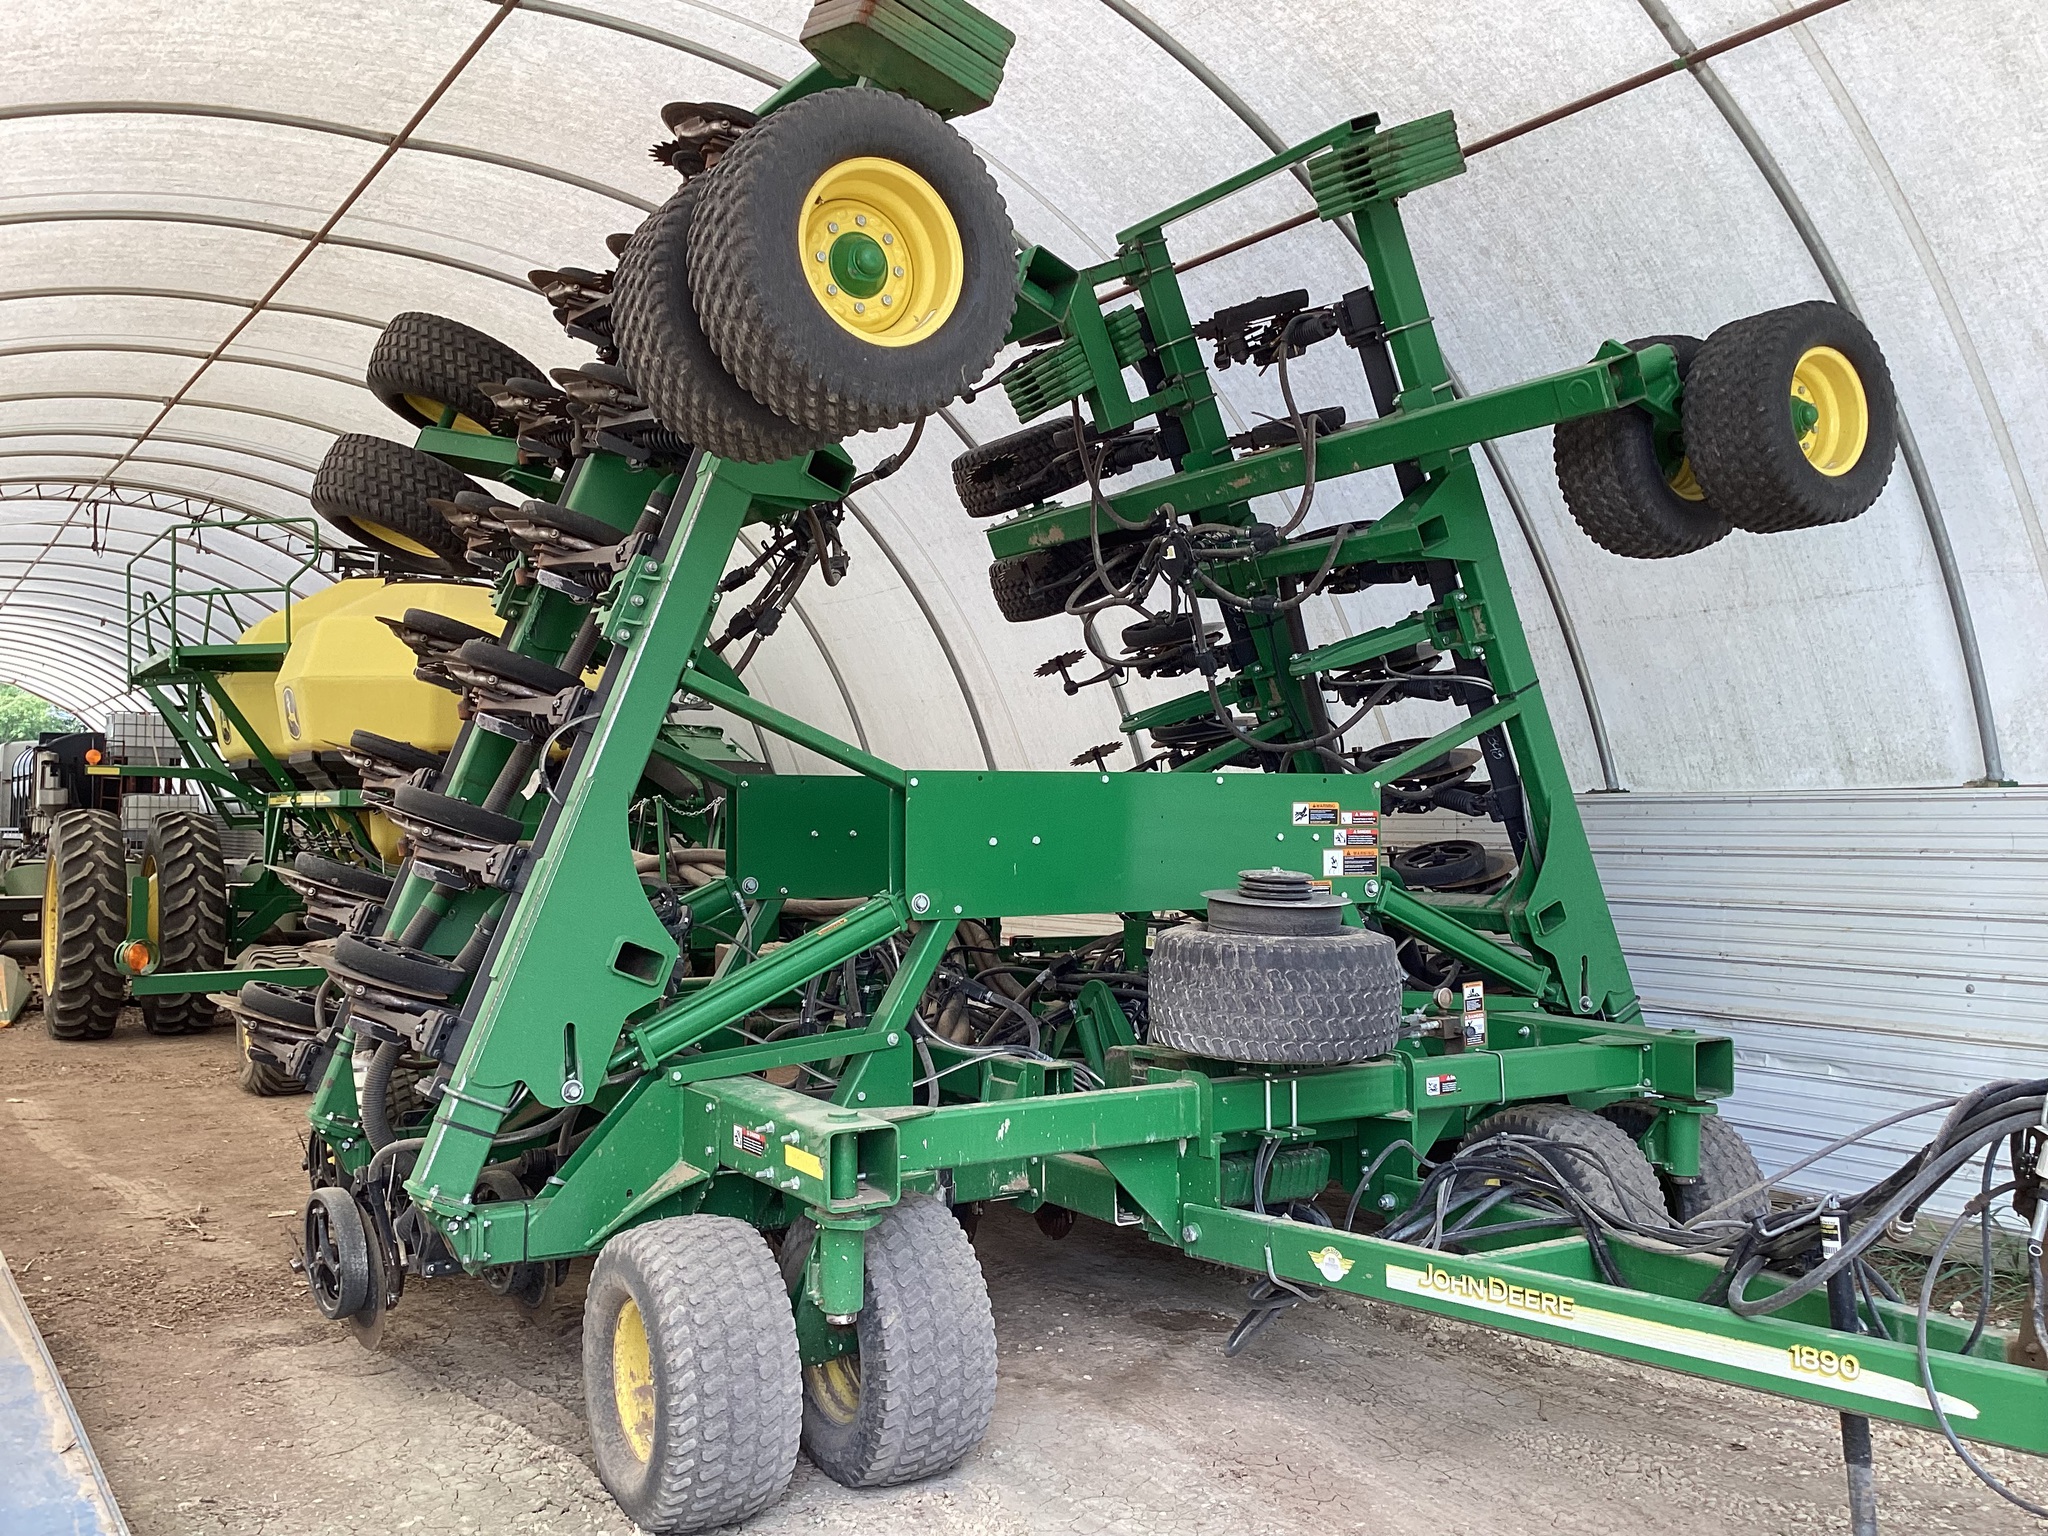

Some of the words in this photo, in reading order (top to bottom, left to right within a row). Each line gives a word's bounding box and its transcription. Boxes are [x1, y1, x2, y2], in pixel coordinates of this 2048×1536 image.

[1419, 1263, 1485, 1299] JOHN
[1487, 1276, 1575, 1319] DEERE
[1788, 1344, 1860, 1381] 1890
